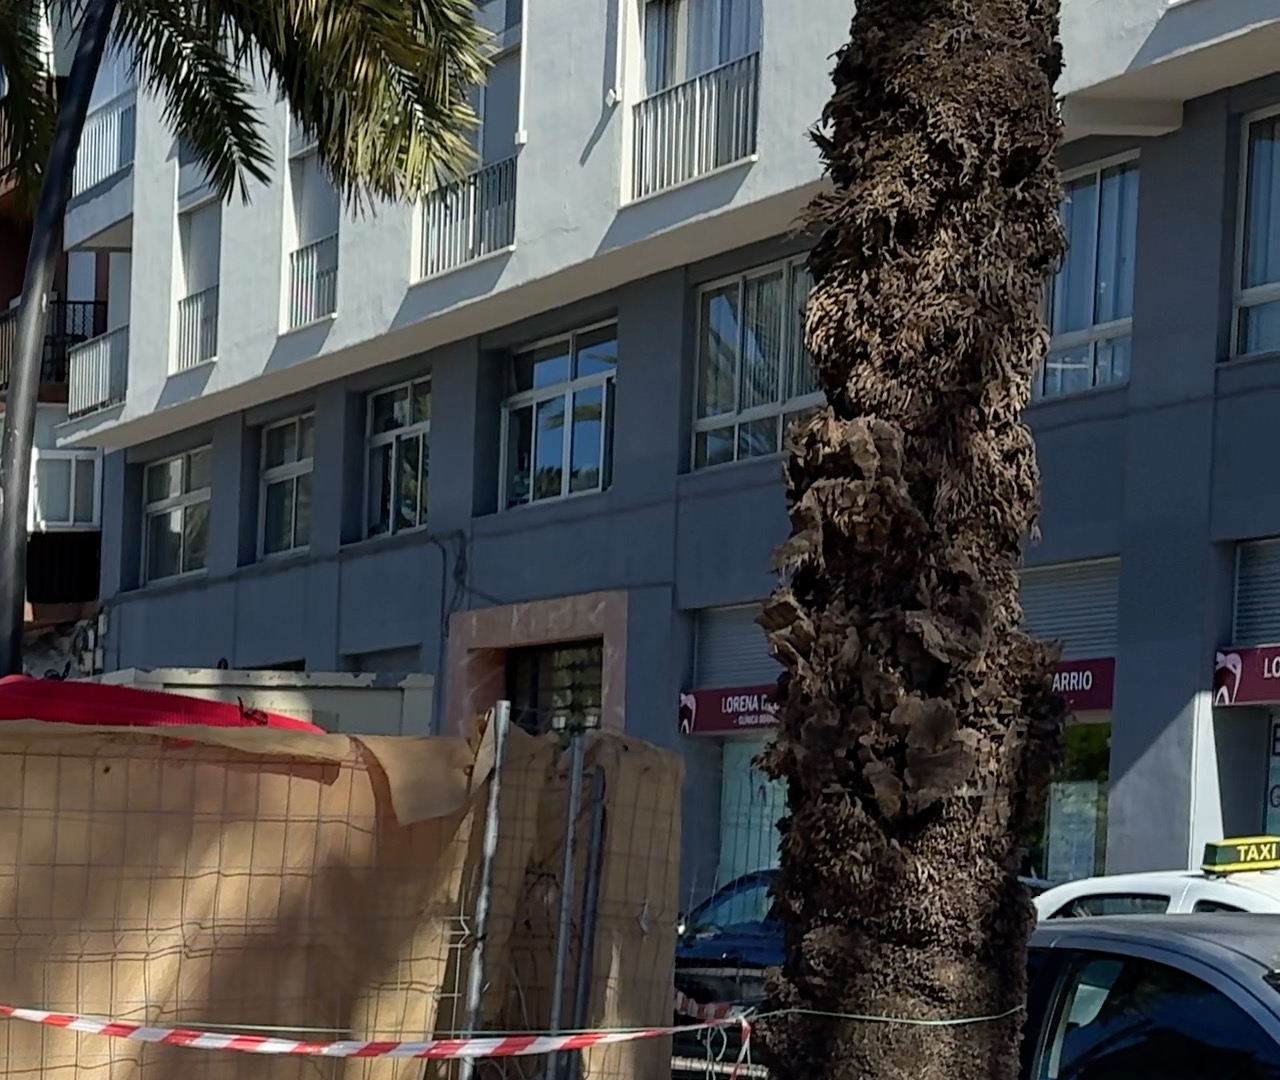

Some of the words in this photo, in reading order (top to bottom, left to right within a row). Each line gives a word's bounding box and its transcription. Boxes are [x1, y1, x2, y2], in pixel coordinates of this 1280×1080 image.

[1051, 670, 1093, 692] ARRIO
[721, 694, 759, 714] LORENA
[1237, 843, 1276, 862] TAXI
